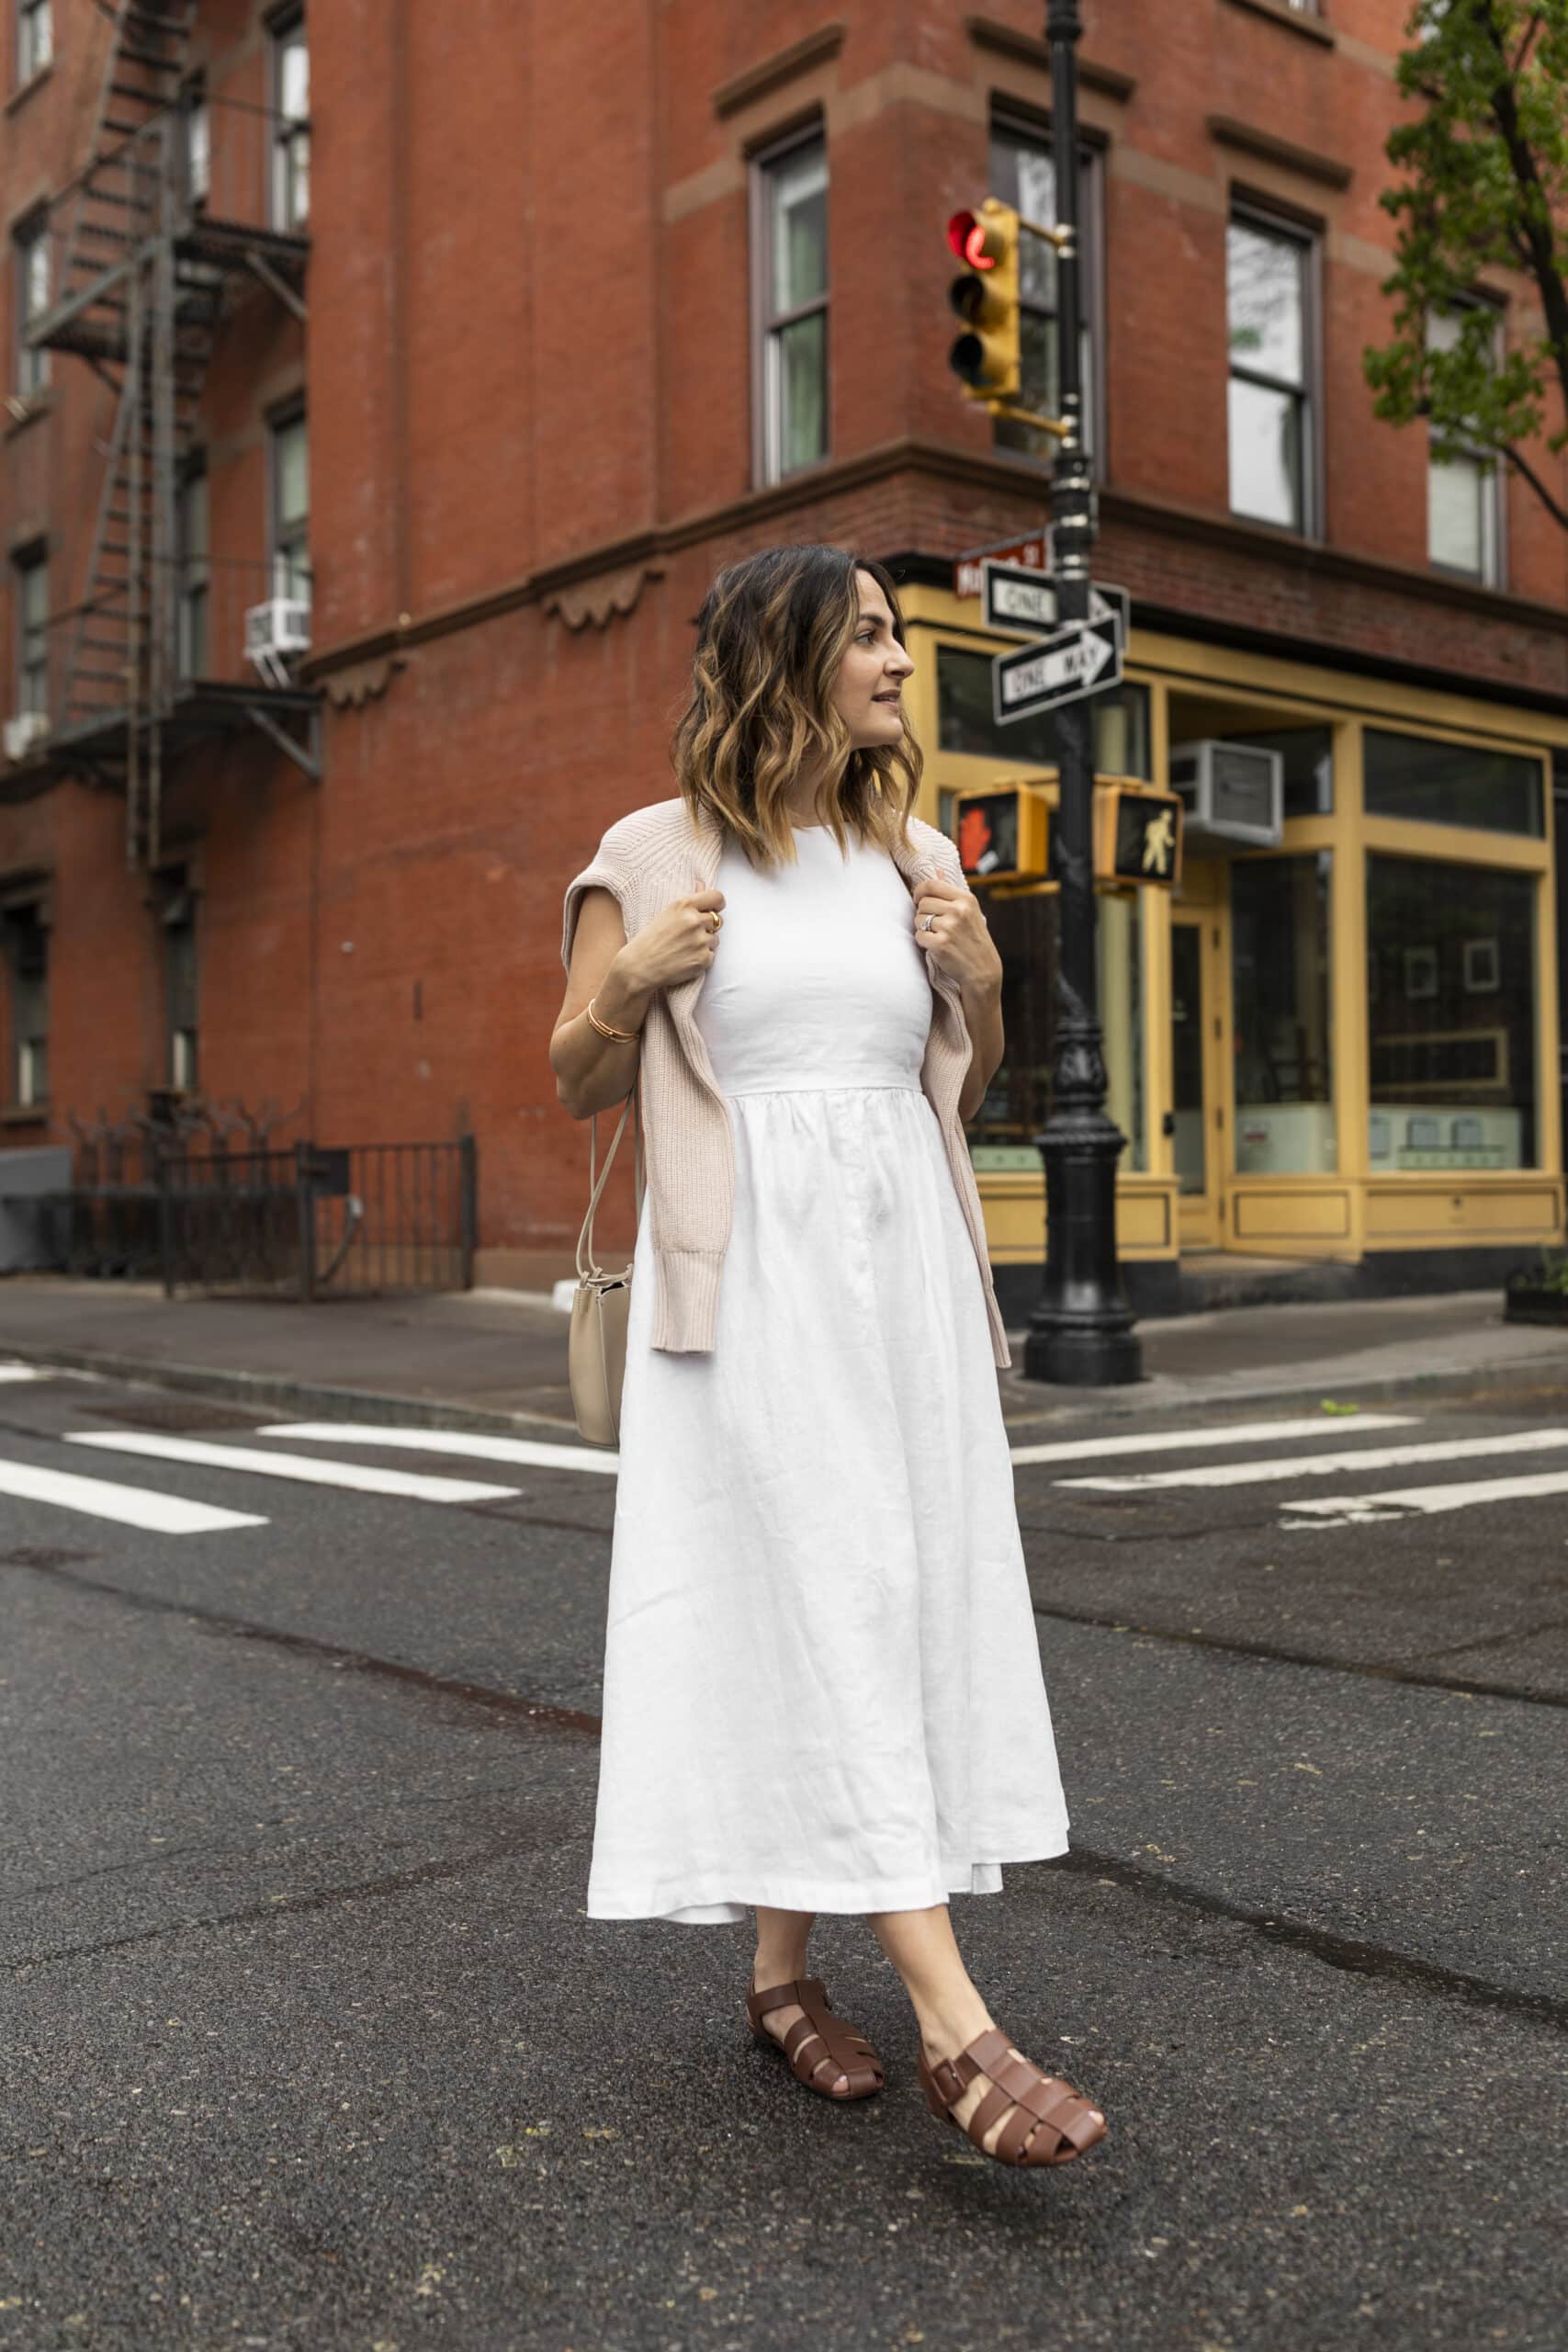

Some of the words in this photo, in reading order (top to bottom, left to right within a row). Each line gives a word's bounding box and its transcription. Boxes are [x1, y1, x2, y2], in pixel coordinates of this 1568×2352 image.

[1005, 585, 1043, 617] ONE
[1014, 661, 1043, 693] ONE
[1064, 647, 1097, 673] WAY
